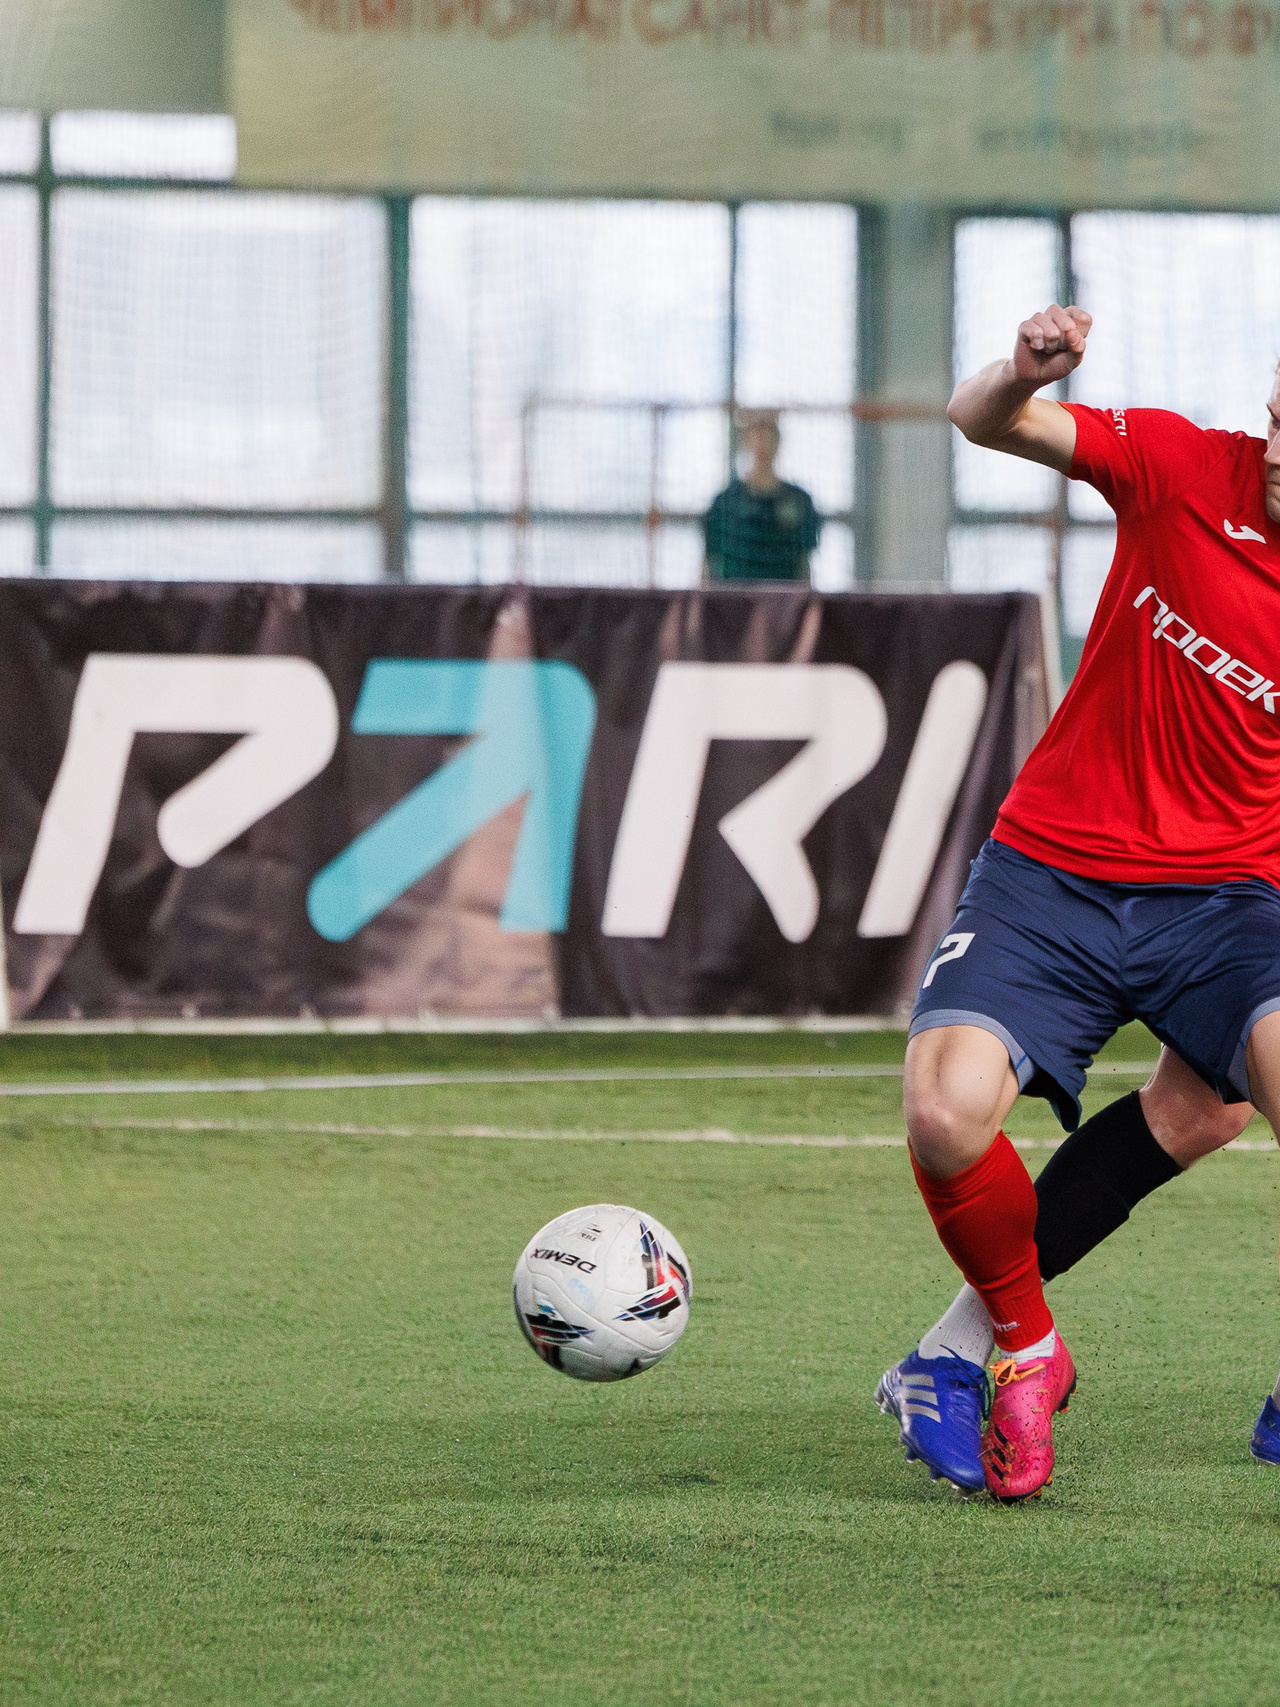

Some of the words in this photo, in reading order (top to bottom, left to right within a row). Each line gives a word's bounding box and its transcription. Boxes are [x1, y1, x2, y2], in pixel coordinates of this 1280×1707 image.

[12, 652, 989, 943] PARI
[922, 932, 976, 989] 7
[530, 1248, 598, 1275] DEMIX
